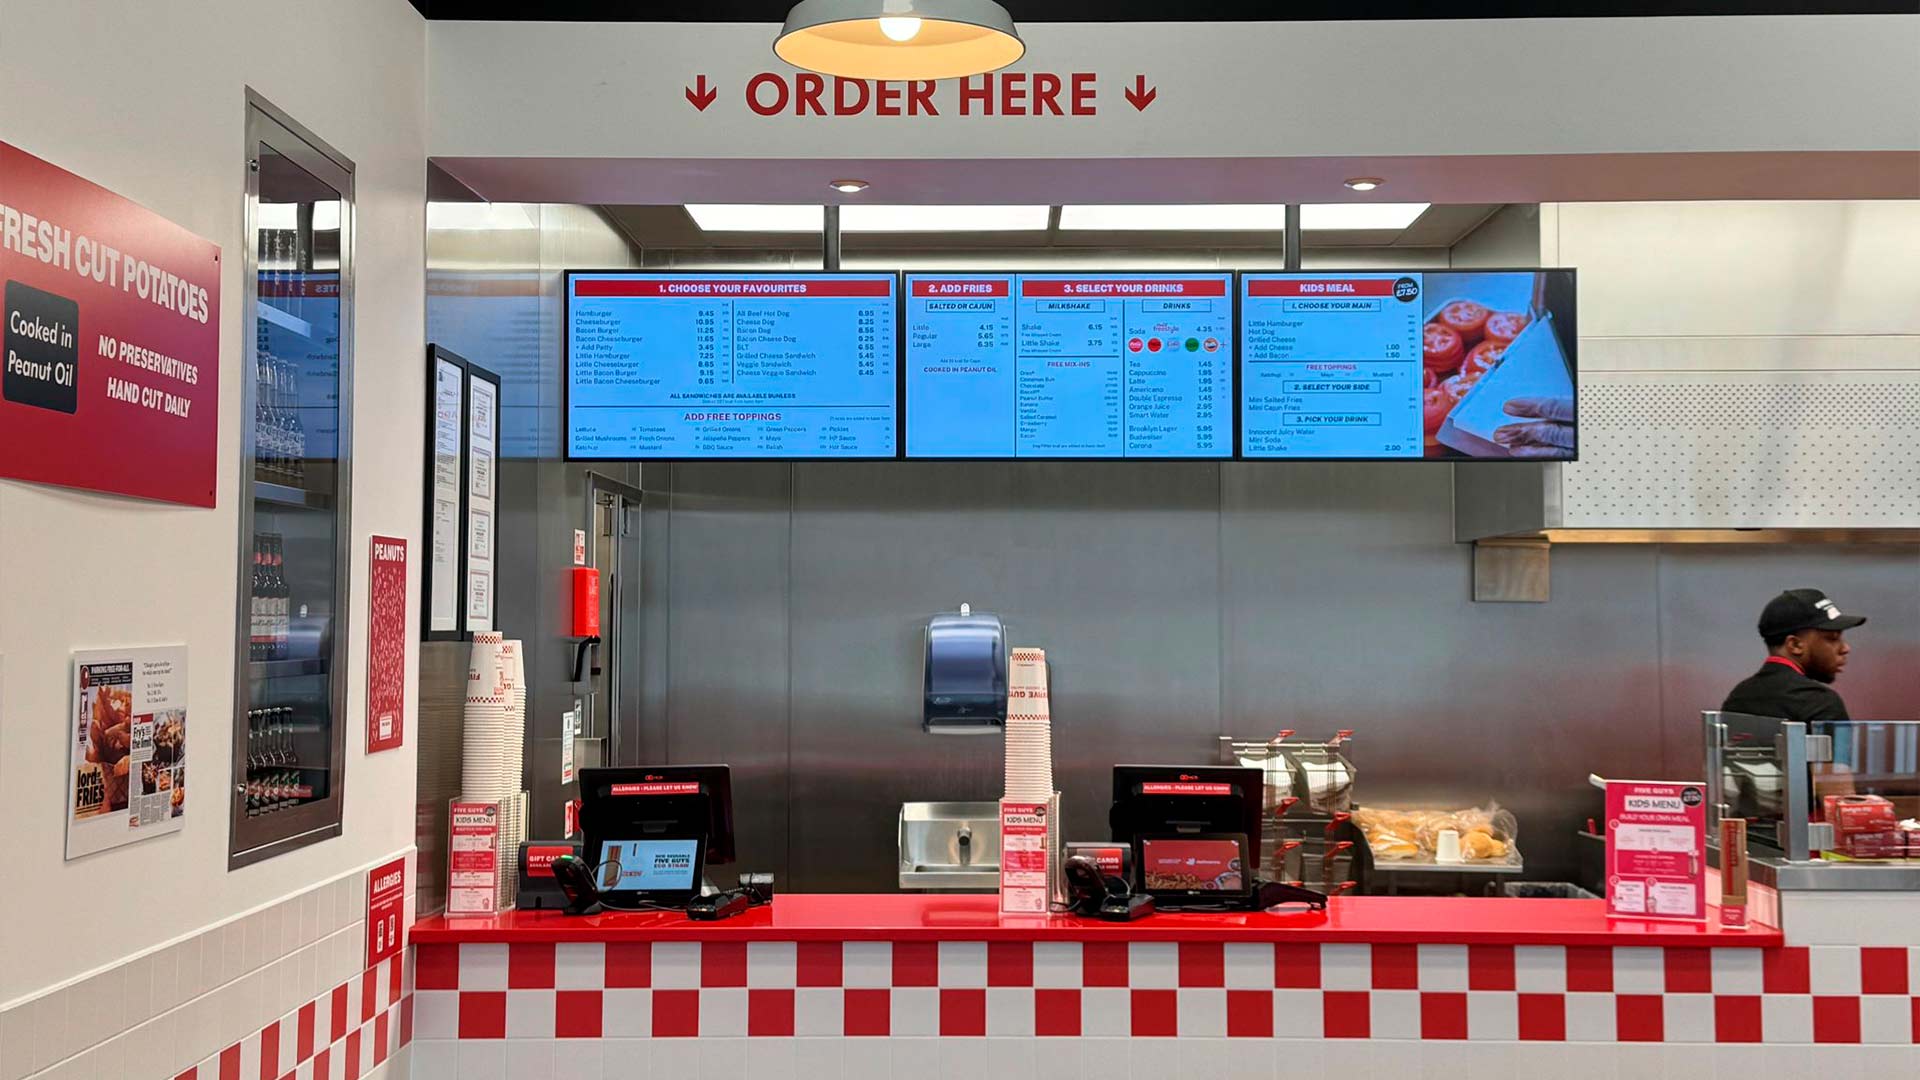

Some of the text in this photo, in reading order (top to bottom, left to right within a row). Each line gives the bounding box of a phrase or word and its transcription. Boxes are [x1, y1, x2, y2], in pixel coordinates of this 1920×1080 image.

[745, 73, 1096, 116] ORDER HERE
[76, 235, 120, 287] CUT
[124, 254, 208, 324] POTATOES
[659, 285, 806, 293] 1. CHOOSE YOUR FAVOURITES
[1300, 283, 1355, 292] KIDS MEAL
[576, 310, 611, 318] Hamburger
[1267, 320, 1303, 328] Hamburger
[11, 311, 72, 349] Cooked in
[8, 350, 72, 386] Peanut Oil
[98, 334, 198, 384] NO PRESERVATIVES
[107, 378, 191, 418] HAND CUT DAILY
[375, 543, 404, 562] PEANUTS
[78, 768, 97, 787] lord
[77, 785, 104, 807] FRIES
[1629, 800, 1650, 808] KIDS
[373, 870, 401, 894] ALLERGIES
